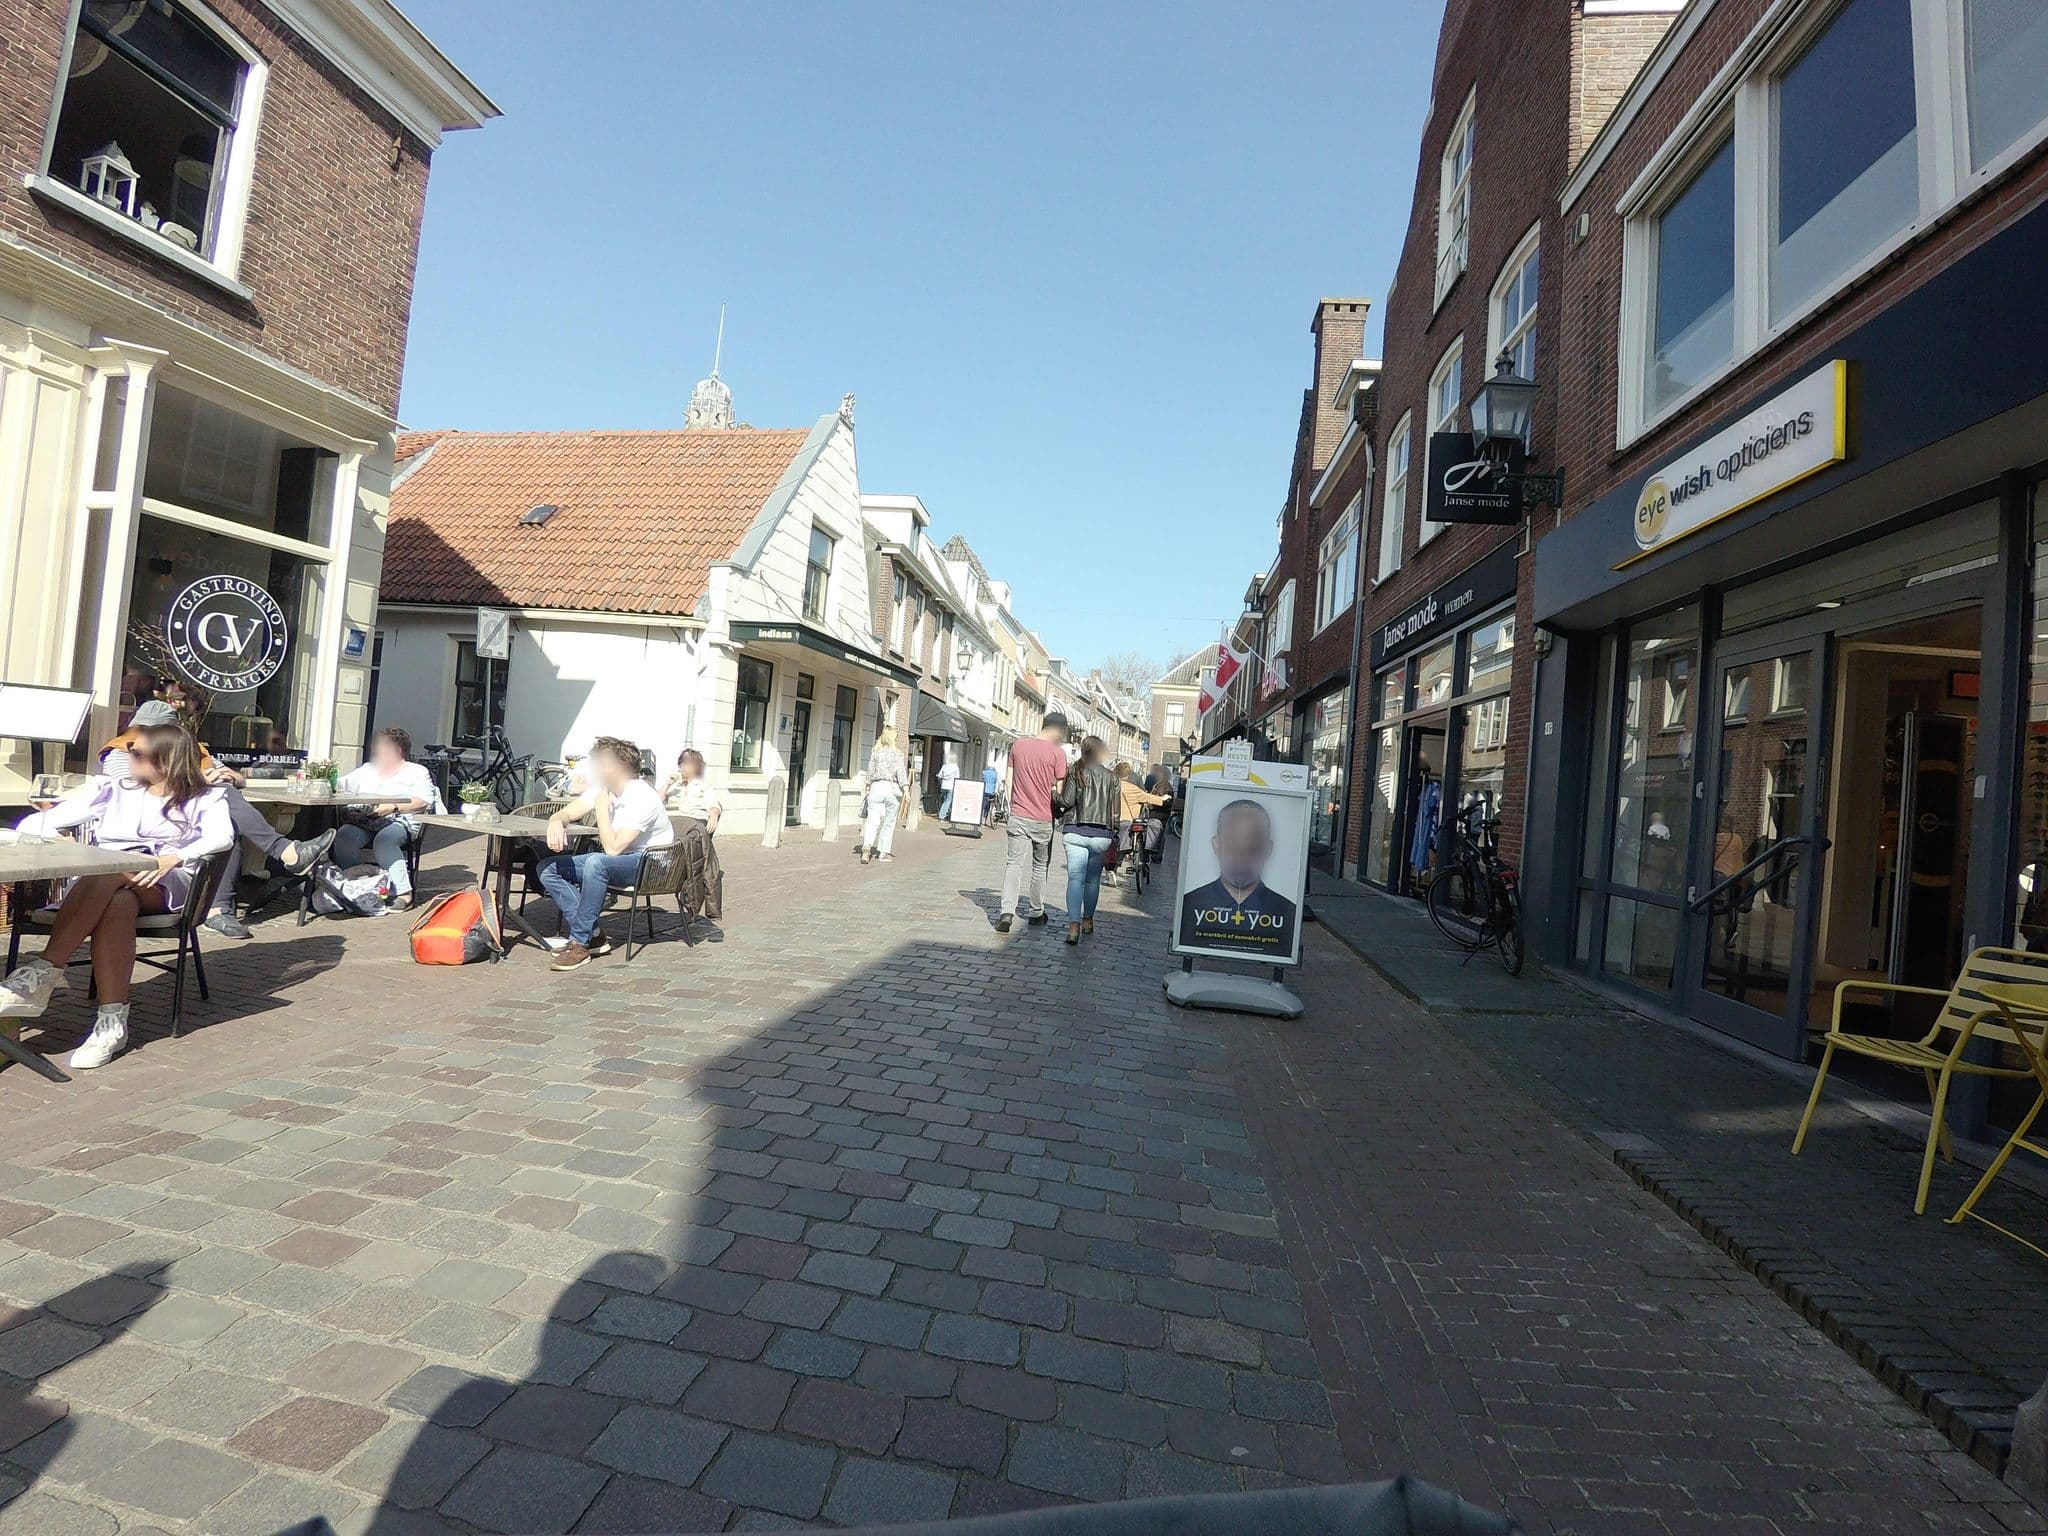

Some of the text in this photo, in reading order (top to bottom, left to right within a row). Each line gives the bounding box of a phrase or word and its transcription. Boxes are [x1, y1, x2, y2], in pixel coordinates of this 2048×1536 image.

[1639, 411, 1814, 527] eye wish opticiens
[1444, 495, 1510, 508] Janse mode
[180, 578, 282, 625] GASTROVINO
[1382, 589, 1474, 657] Janse mode women
[197, 612, 263, 655] GV
[758, 628, 793, 639] Indiaas
[175, 644, 277, 689] BY FRANCES
[259, 754, 299, 764] BORREL
